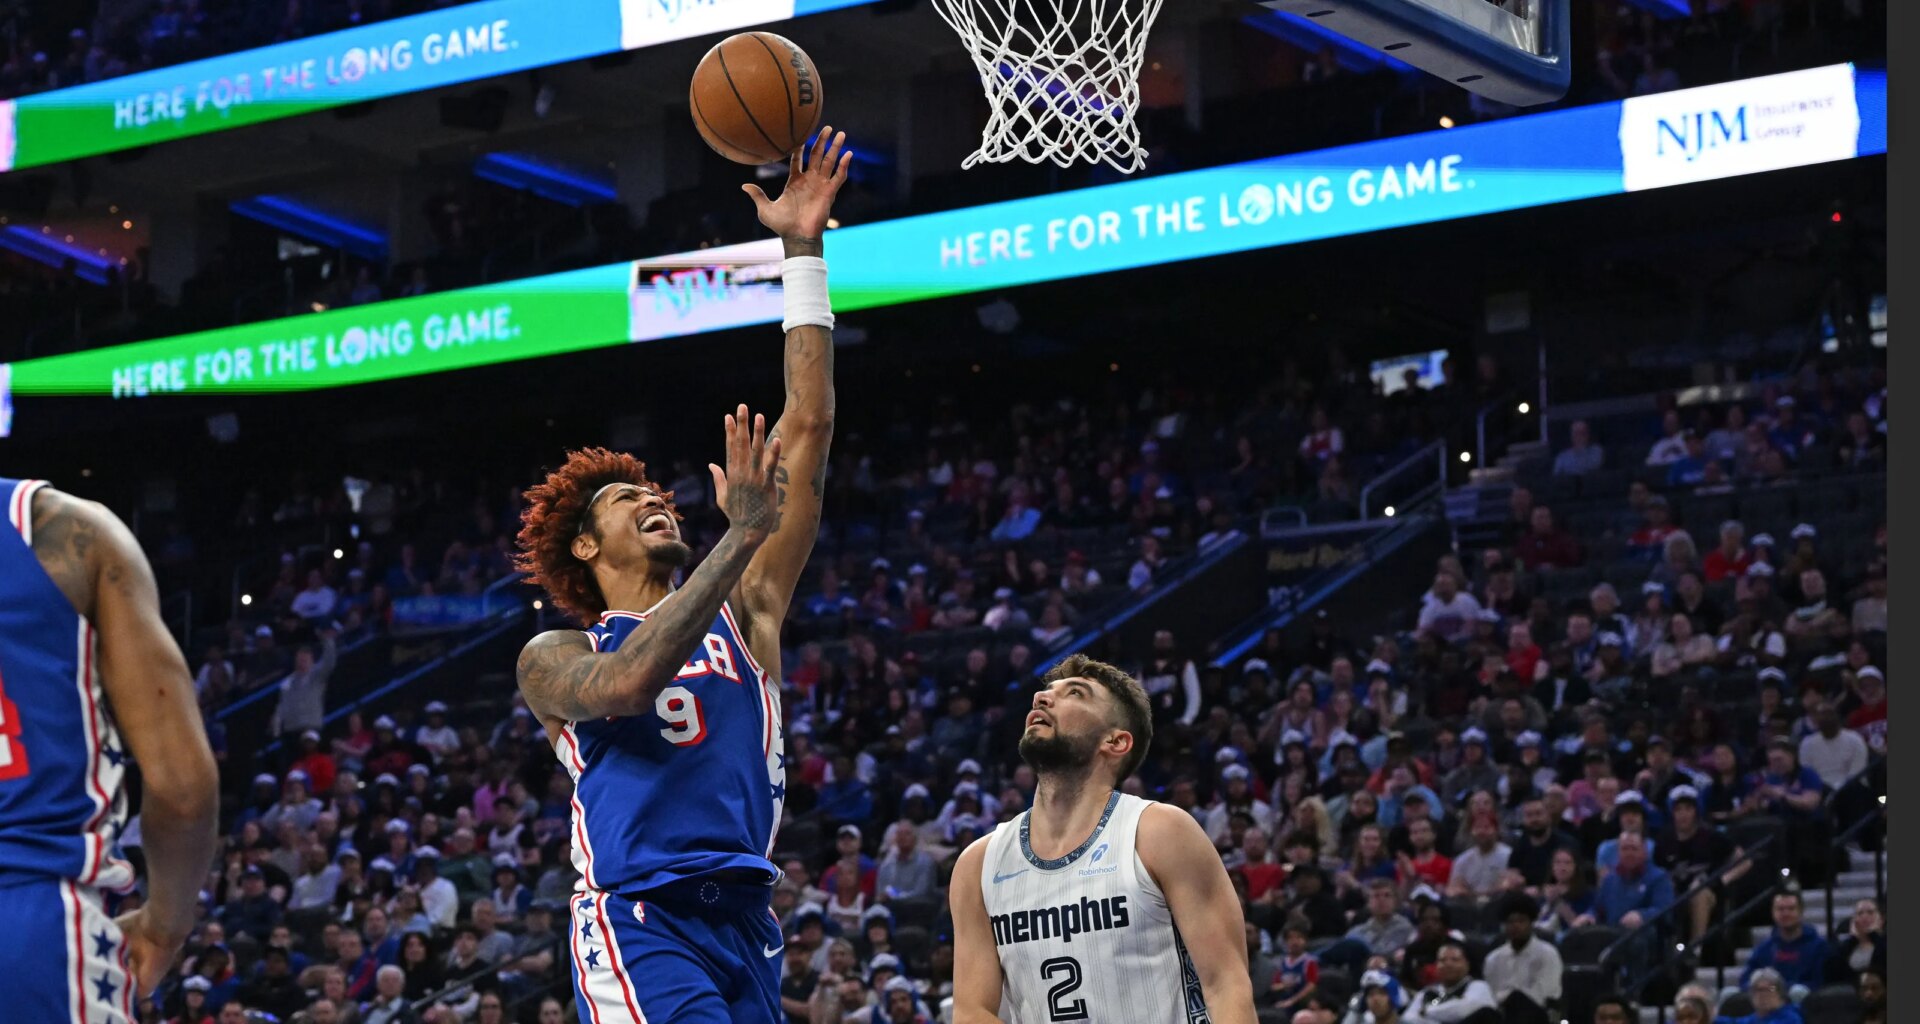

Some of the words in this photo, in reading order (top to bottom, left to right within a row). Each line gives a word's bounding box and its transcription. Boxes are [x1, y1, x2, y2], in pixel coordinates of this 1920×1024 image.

[114, 85, 186, 129] HERE
[195, 73, 252, 113] FOR
[262, 59, 315, 97] THE
[326, 40, 413, 85] LONG
[421, 19, 519, 65] GAME.
[1656, 105, 1748, 162] NJM
[940, 224, 1034, 269] HERE
[1047, 211, 1121, 253] FOR
[1131, 196, 1206, 238] THE
[1219, 175, 1334, 227] LONG
[1347, 154, 1476, 207] GAME.
[112, 358, 187, 399] HERE
[194, 347, 253, 385] FOR
[260, 335, 318, 377] THE
[325, 319, 414, 367] LONG
[423, 304, 521, 351] GAME.
[655, 686, 708, 747] 9
[1078, 864, 1118, 877] Robinhood
[1040, 956, 1089, 1022] 2
